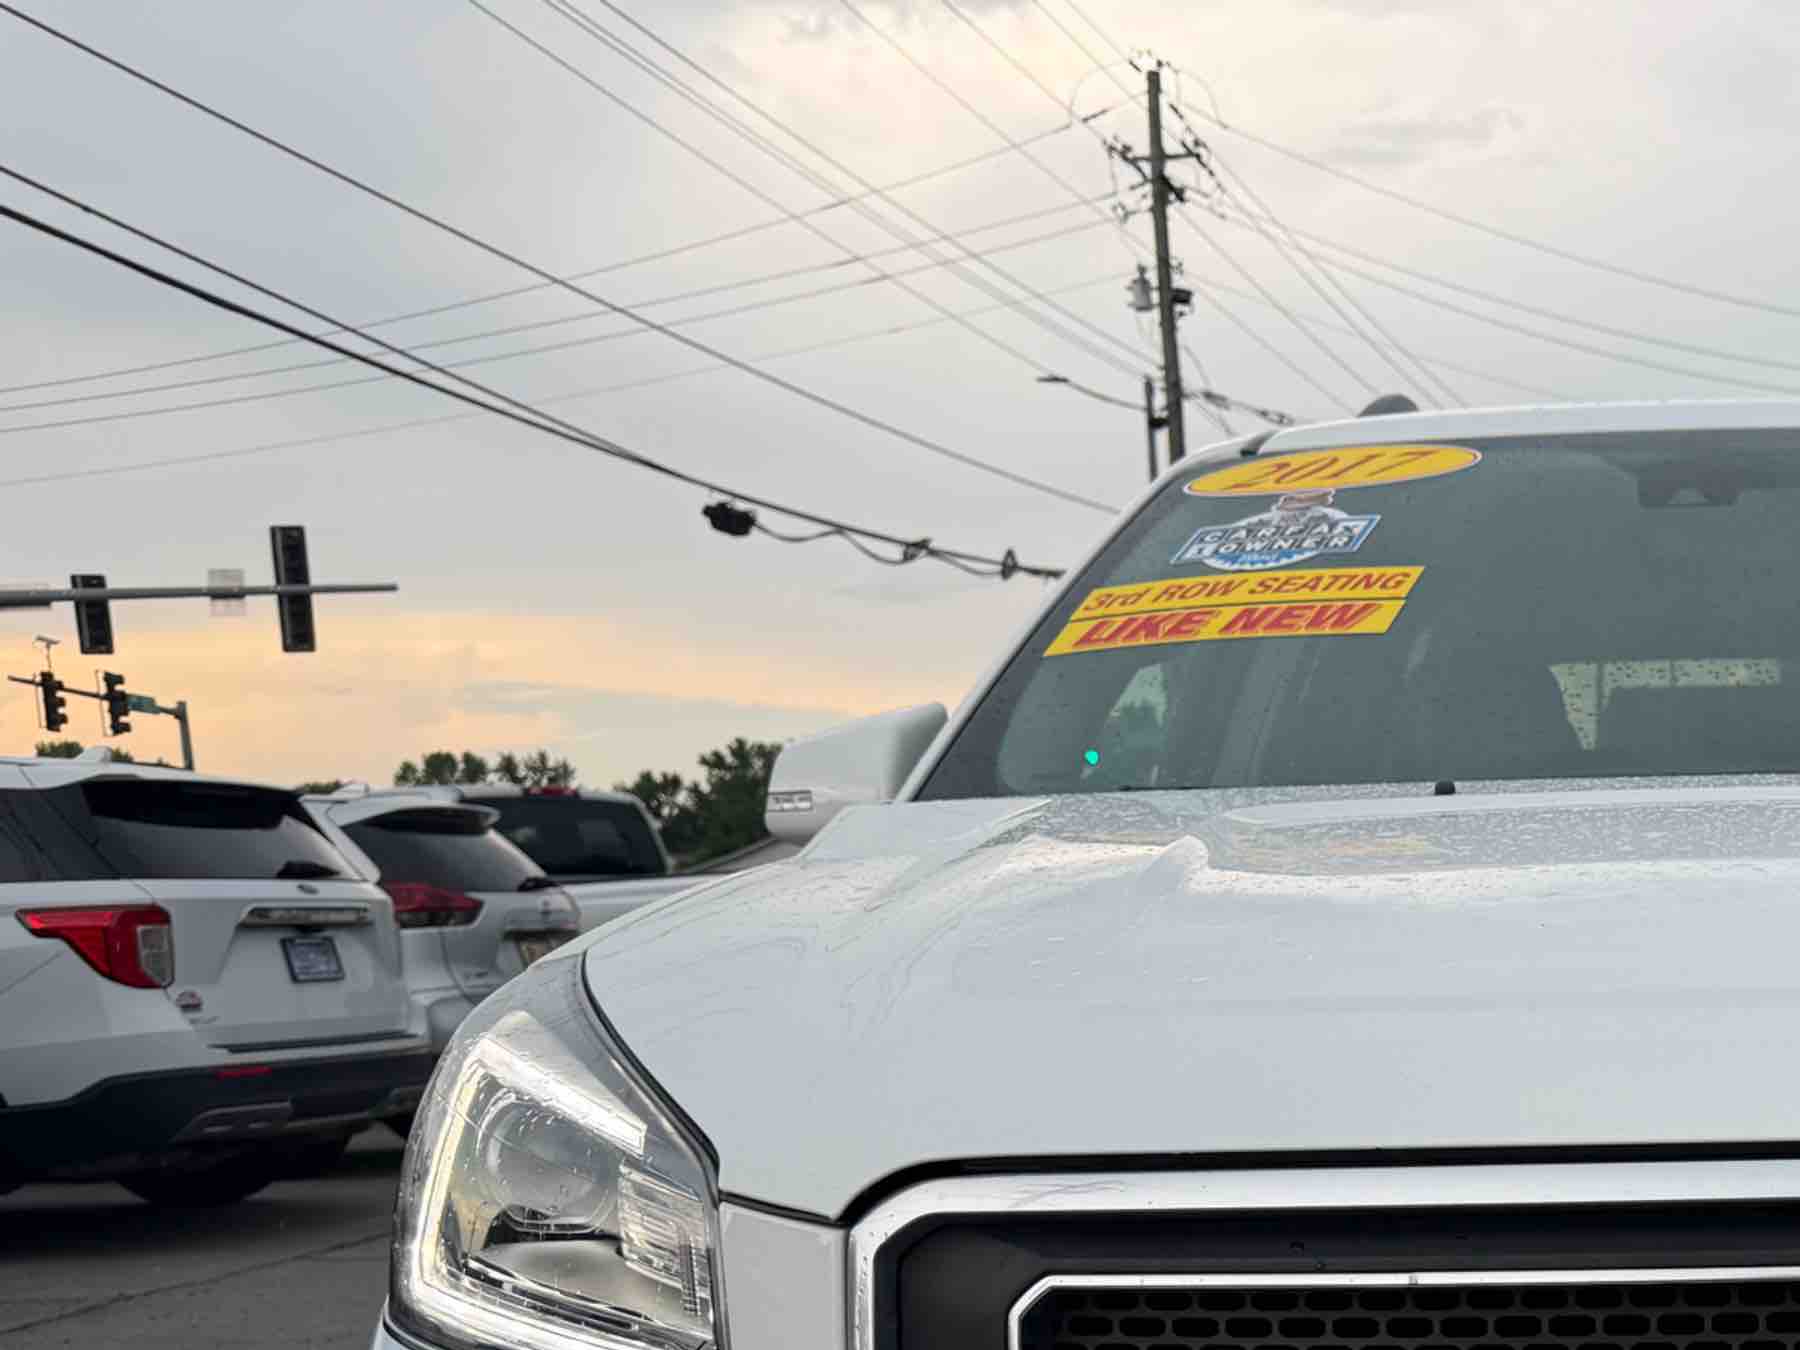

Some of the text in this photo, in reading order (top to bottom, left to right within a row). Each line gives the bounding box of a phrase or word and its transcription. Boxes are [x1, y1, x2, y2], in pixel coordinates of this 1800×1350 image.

[1221, 449, 1441, 489] 2017
[1221, 536, 1349, 554] OWNER
[1083, 571, 1411, 611] 3rd ROW SEATING
[1072, 602, 1383, 648] LIKE NEW
